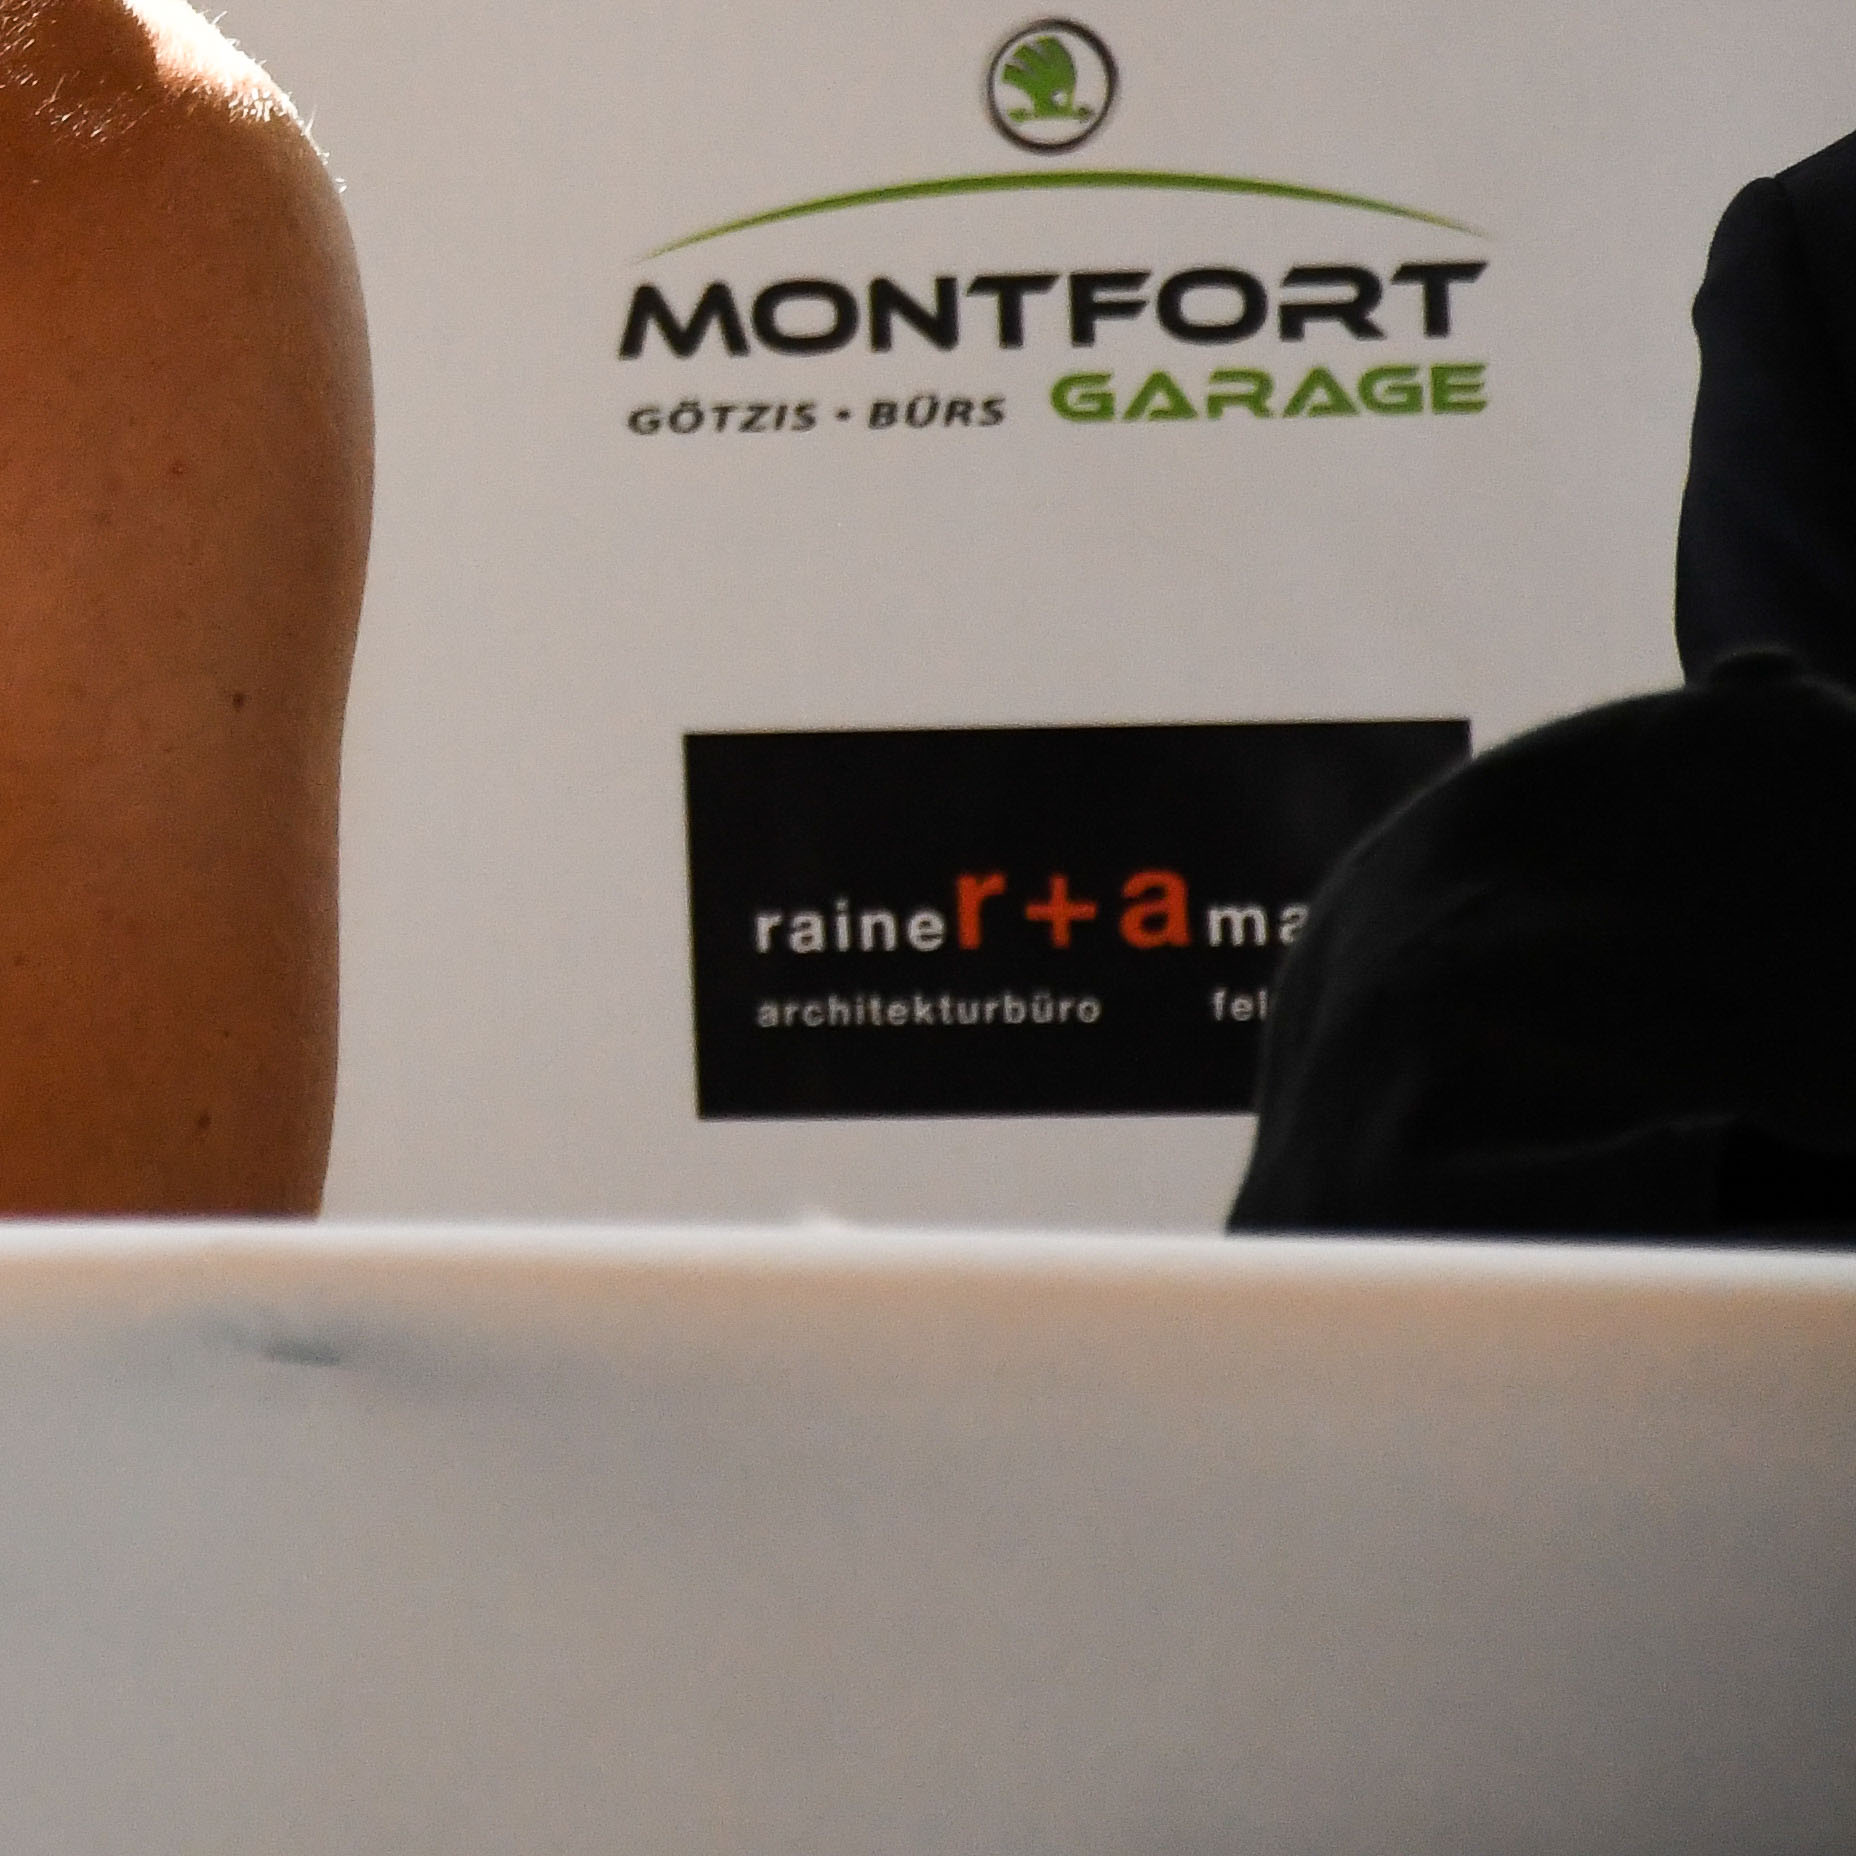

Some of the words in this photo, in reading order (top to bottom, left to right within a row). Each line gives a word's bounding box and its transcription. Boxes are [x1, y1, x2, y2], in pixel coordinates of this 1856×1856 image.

[618, 260, 1488, 361] MONTFORT
[627, 396, 817, 436] GÖTZIS
[868, 393, 1007, 431] BÜRS
[1049, 362, 1488, 425] GARAGE
[755, 992, 1103, 1028] architekturbüro
